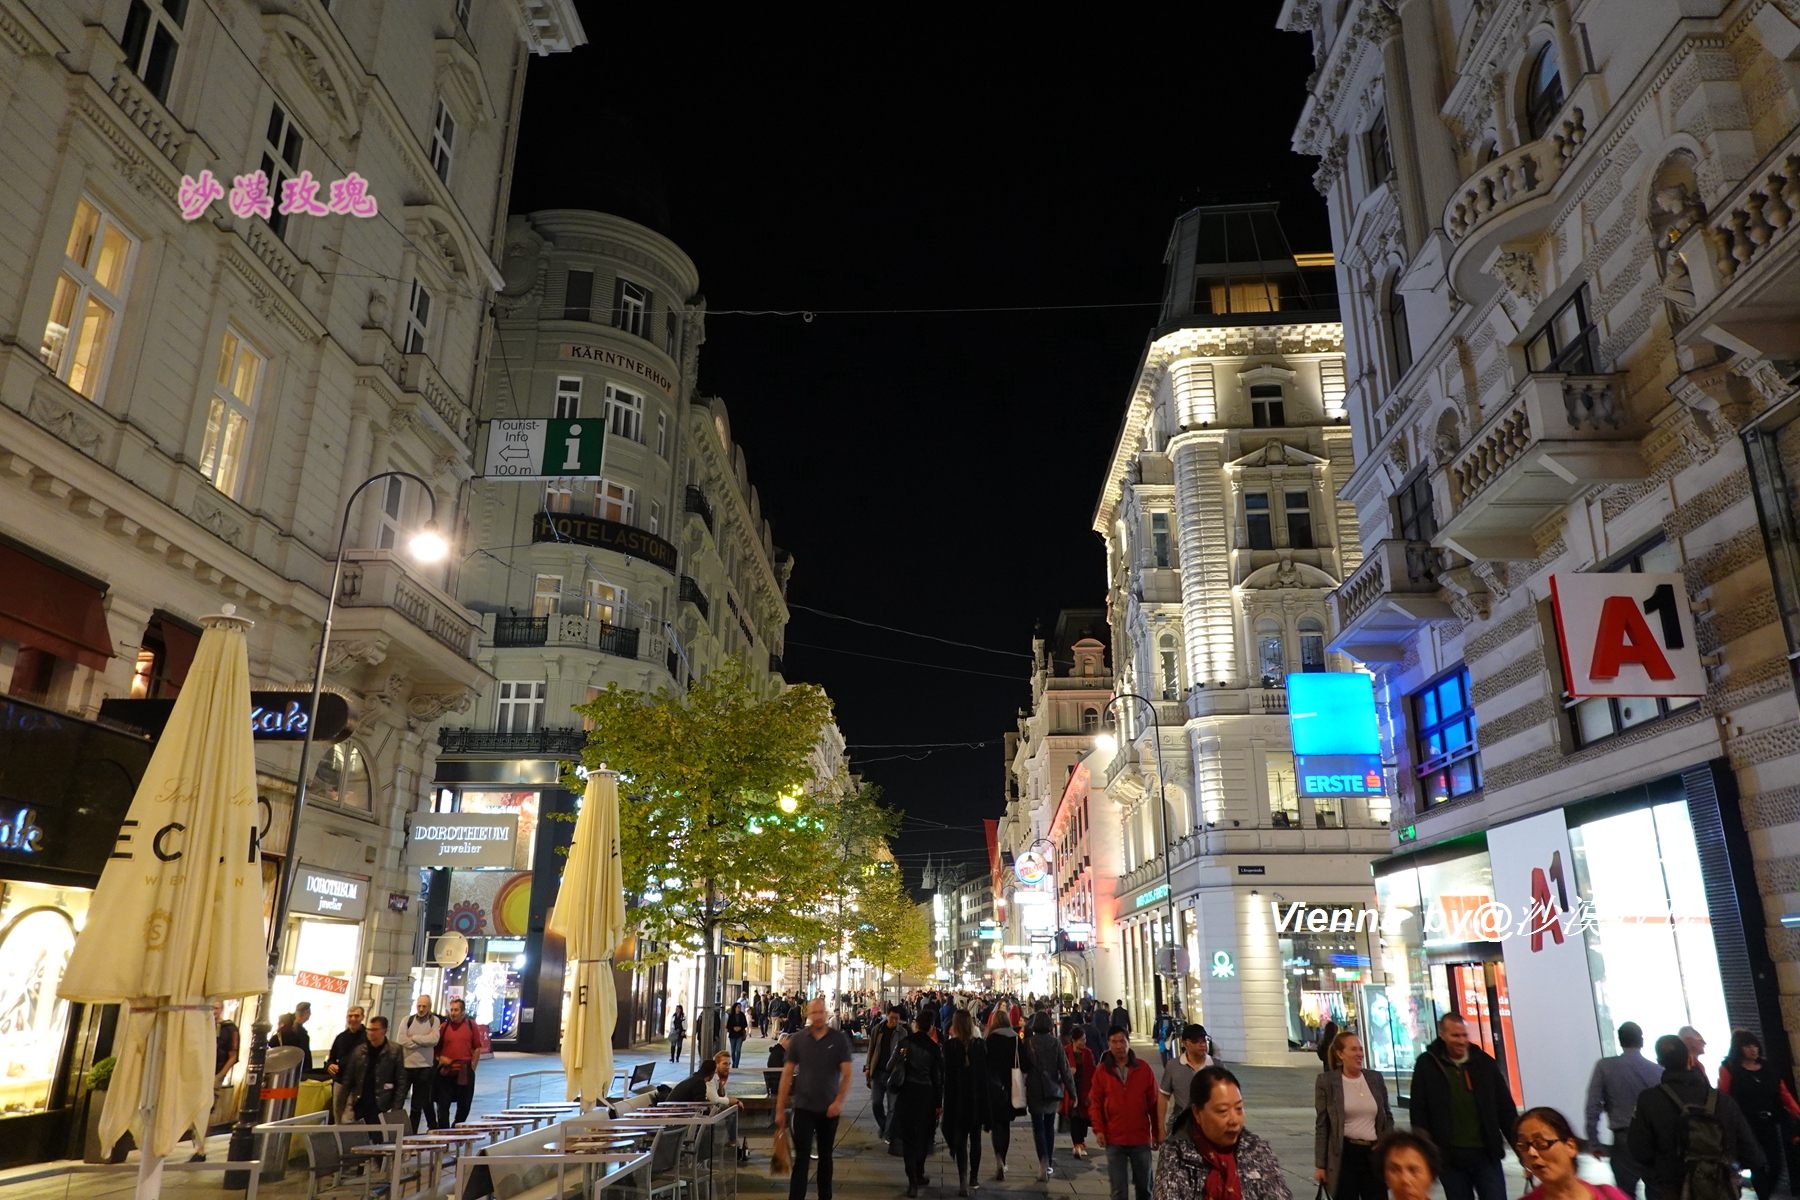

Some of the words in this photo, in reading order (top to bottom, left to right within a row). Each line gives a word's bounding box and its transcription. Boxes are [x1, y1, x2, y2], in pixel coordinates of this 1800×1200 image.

[571, 346, 672, 393] KÄRNTNERHOF
[497, 420, 540, 431] Tourist-
[505, 431, 529, 442] Info
[493, 465, 517, 475] 100
[519, 467, 532, 475] m
[541, 517, 612, 543] HOTEL
[1589, 584, 1685, 681] A1
[1305, 775, 1365, 793] ERSTE
[414, 825, 510, 841] DOROTHEUM
[438, 842, 482, 856] juwelier
[306, 875, 358, 899] DOROTHEUM
[1531, 850, 1569, 953] A1
